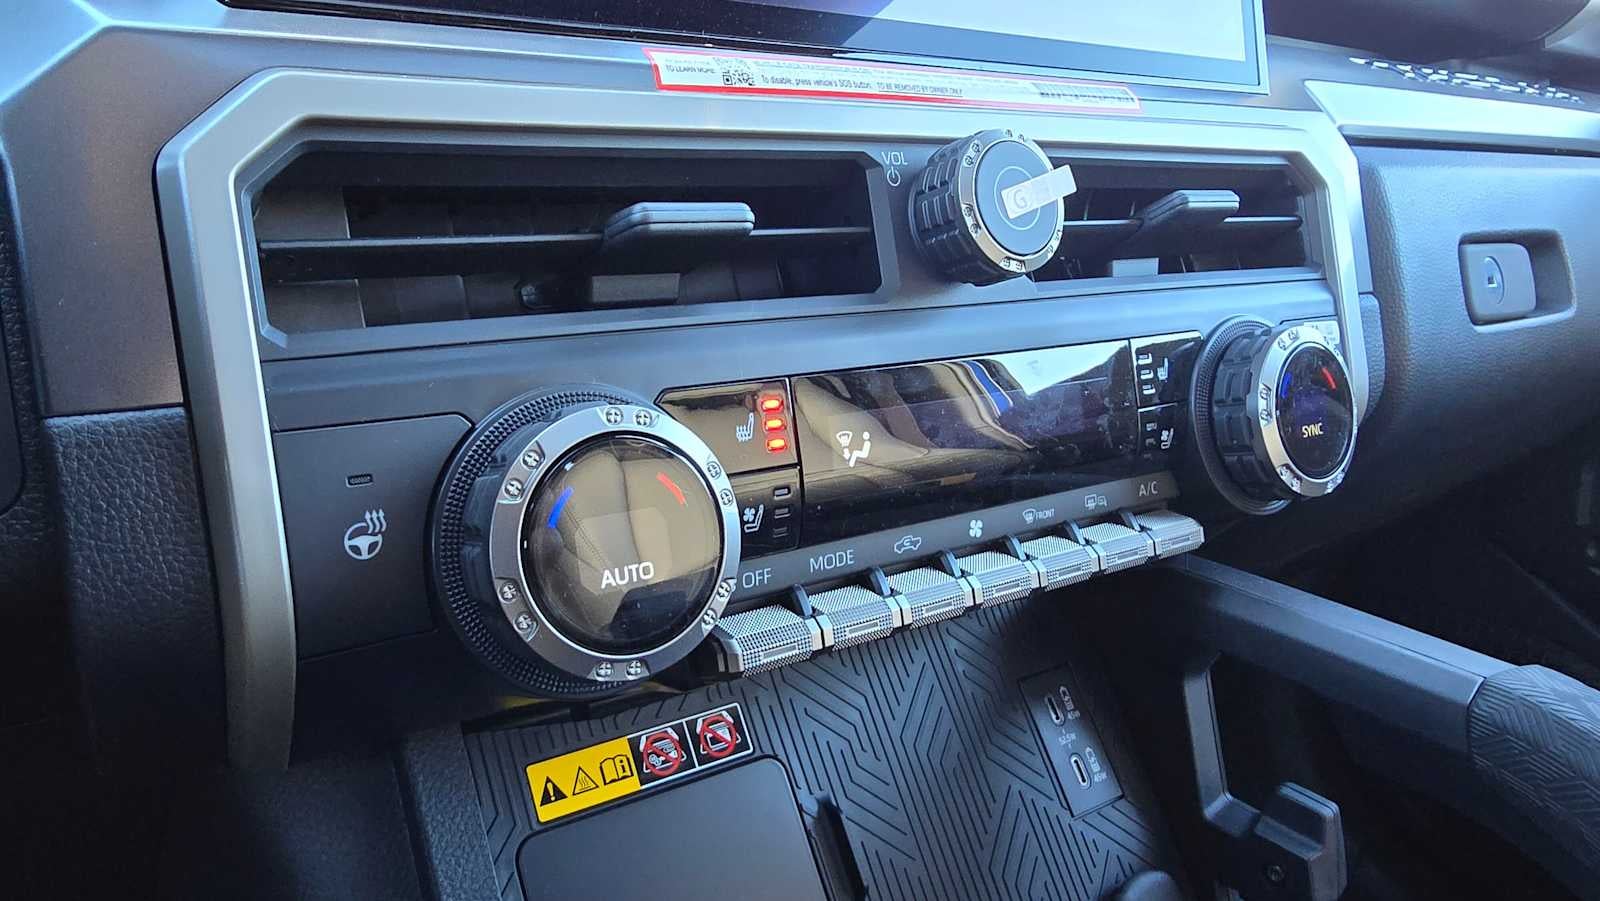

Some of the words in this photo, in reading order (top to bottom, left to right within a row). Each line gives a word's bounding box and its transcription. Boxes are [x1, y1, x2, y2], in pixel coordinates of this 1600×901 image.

[676, 65, 697, 73] LEARN
[761, 73, 769, 84] To
[795, 78, 811, 87] press
[881, 151, 908, 166] VOL
[1301, 422, 1324, 438] SYNC
[1138, 480, 1158, 497] A/C
[1035, 507, 1055, 521] FRONT
[809, 550, 855, 573] MODE
[601, 561, 654, 589] AUTO
[742, 567, 772, 588] OFF
